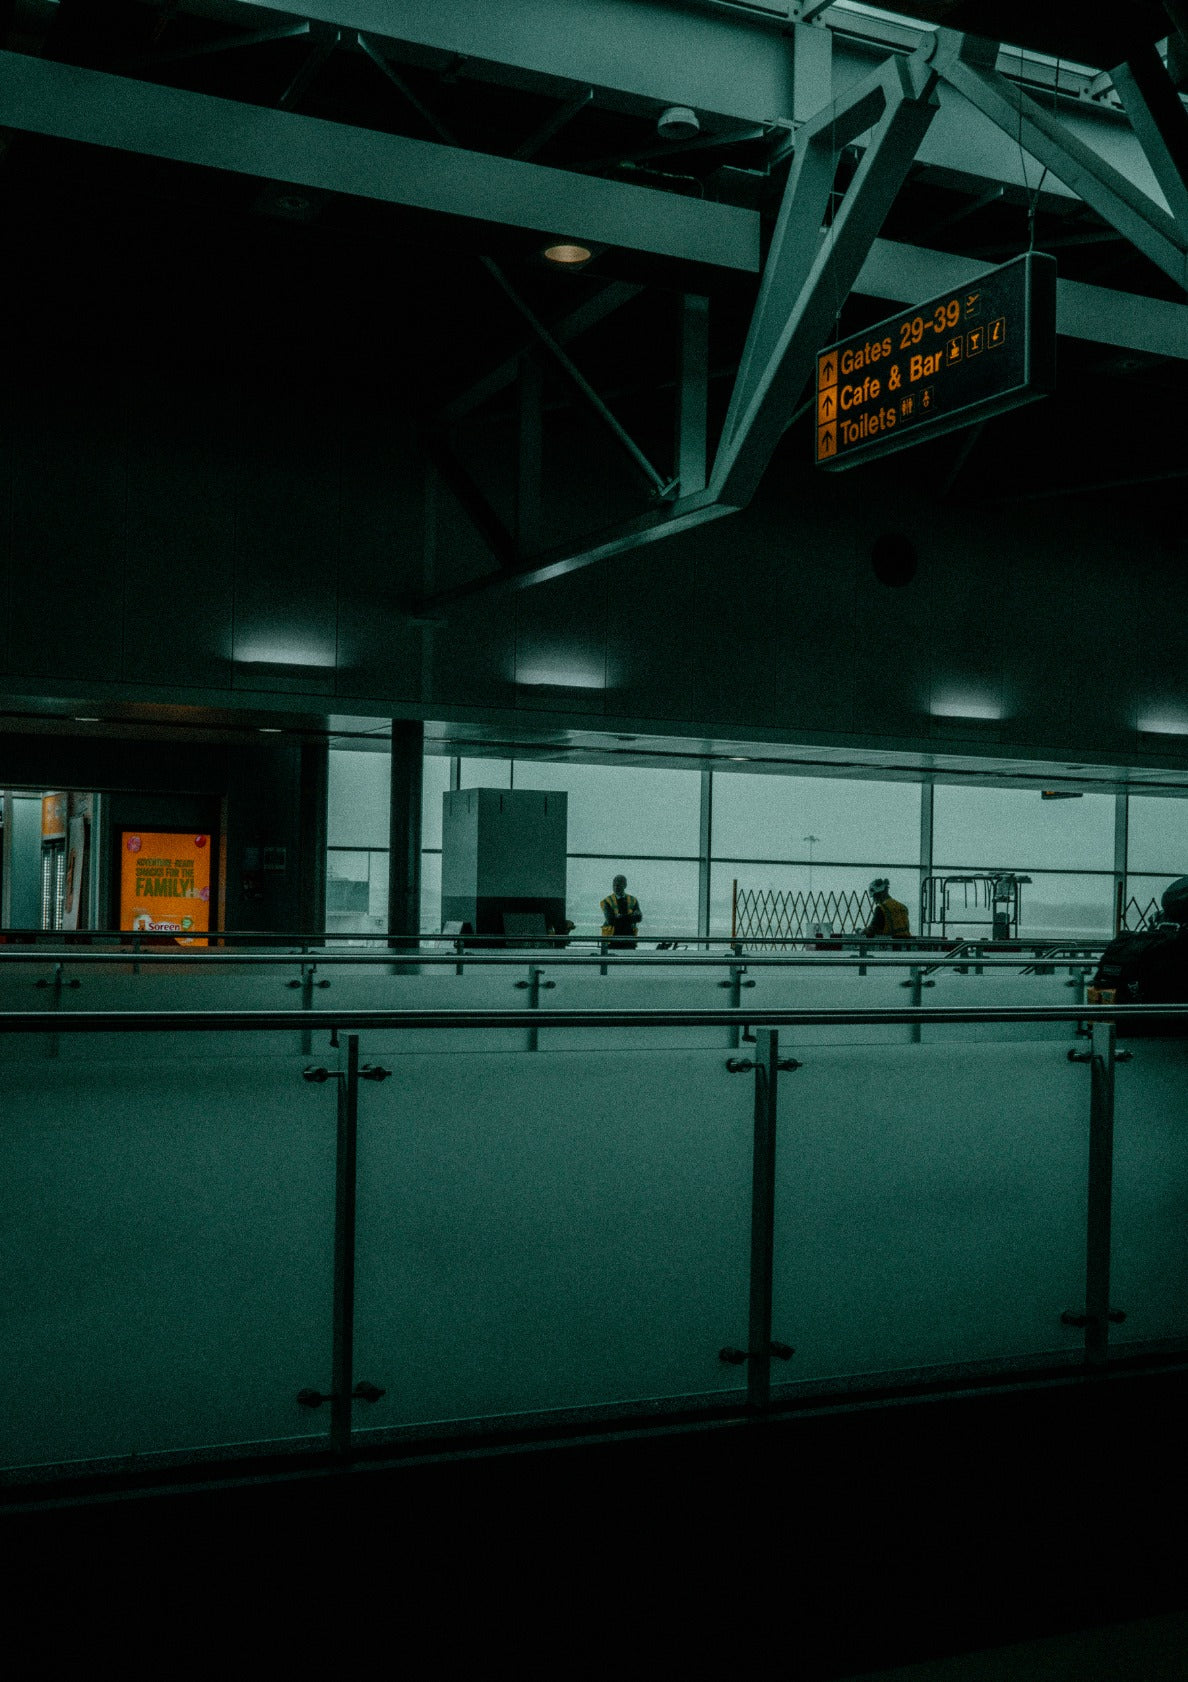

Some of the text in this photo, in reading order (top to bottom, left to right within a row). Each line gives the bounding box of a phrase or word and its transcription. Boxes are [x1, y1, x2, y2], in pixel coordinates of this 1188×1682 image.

[840, 300, 961, 375] Gates 29-39
[839, 350, 943, 411] Cafe & Bar
[840, 407, 897, 445] Toilets
[136, 877, 194, 897] FAMILY!
[148, 922, 181, 931] Soreen
